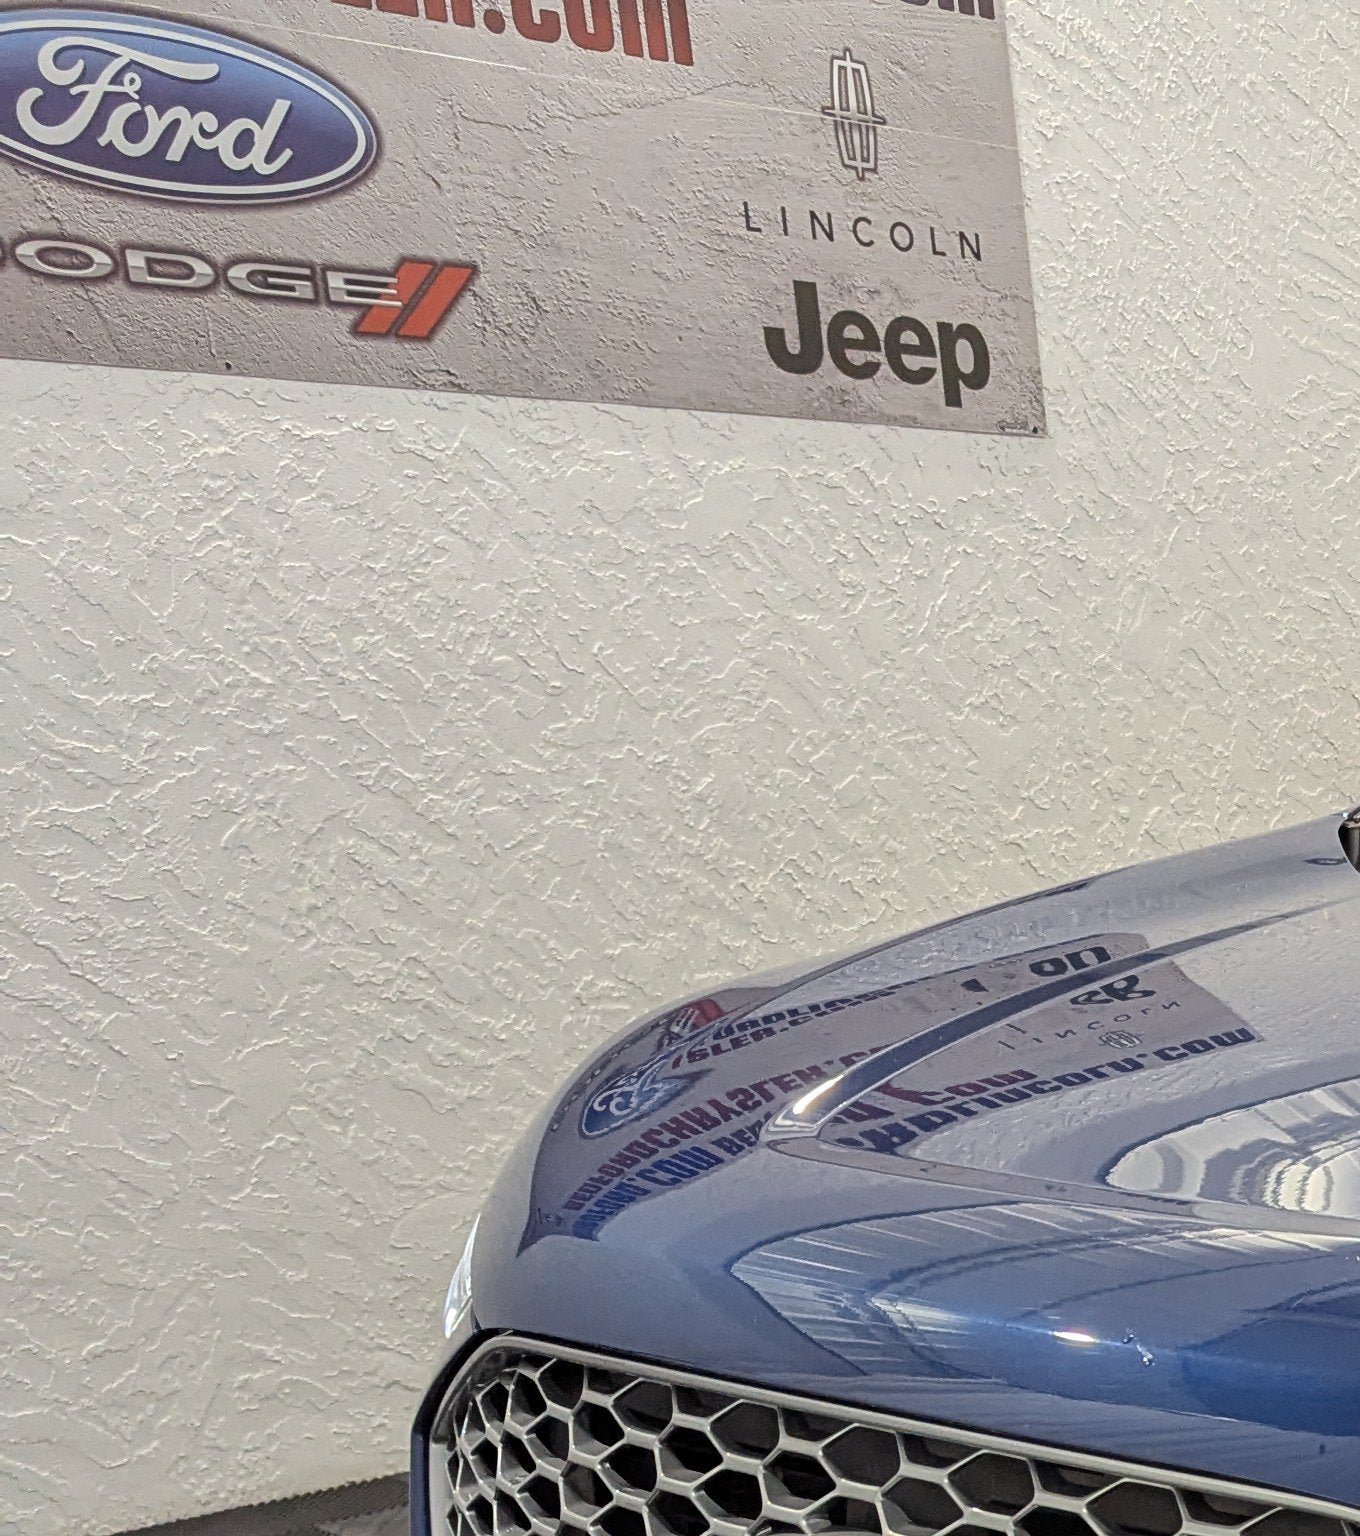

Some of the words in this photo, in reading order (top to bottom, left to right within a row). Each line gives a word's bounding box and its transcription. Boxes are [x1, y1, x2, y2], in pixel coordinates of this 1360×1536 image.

[16, 37, 293, 175] Ford
[14, 239, 403, 308] ODGE
[743, 201, 981, 261] LINCOLN
[763, 279, 990, 408] Jeep
